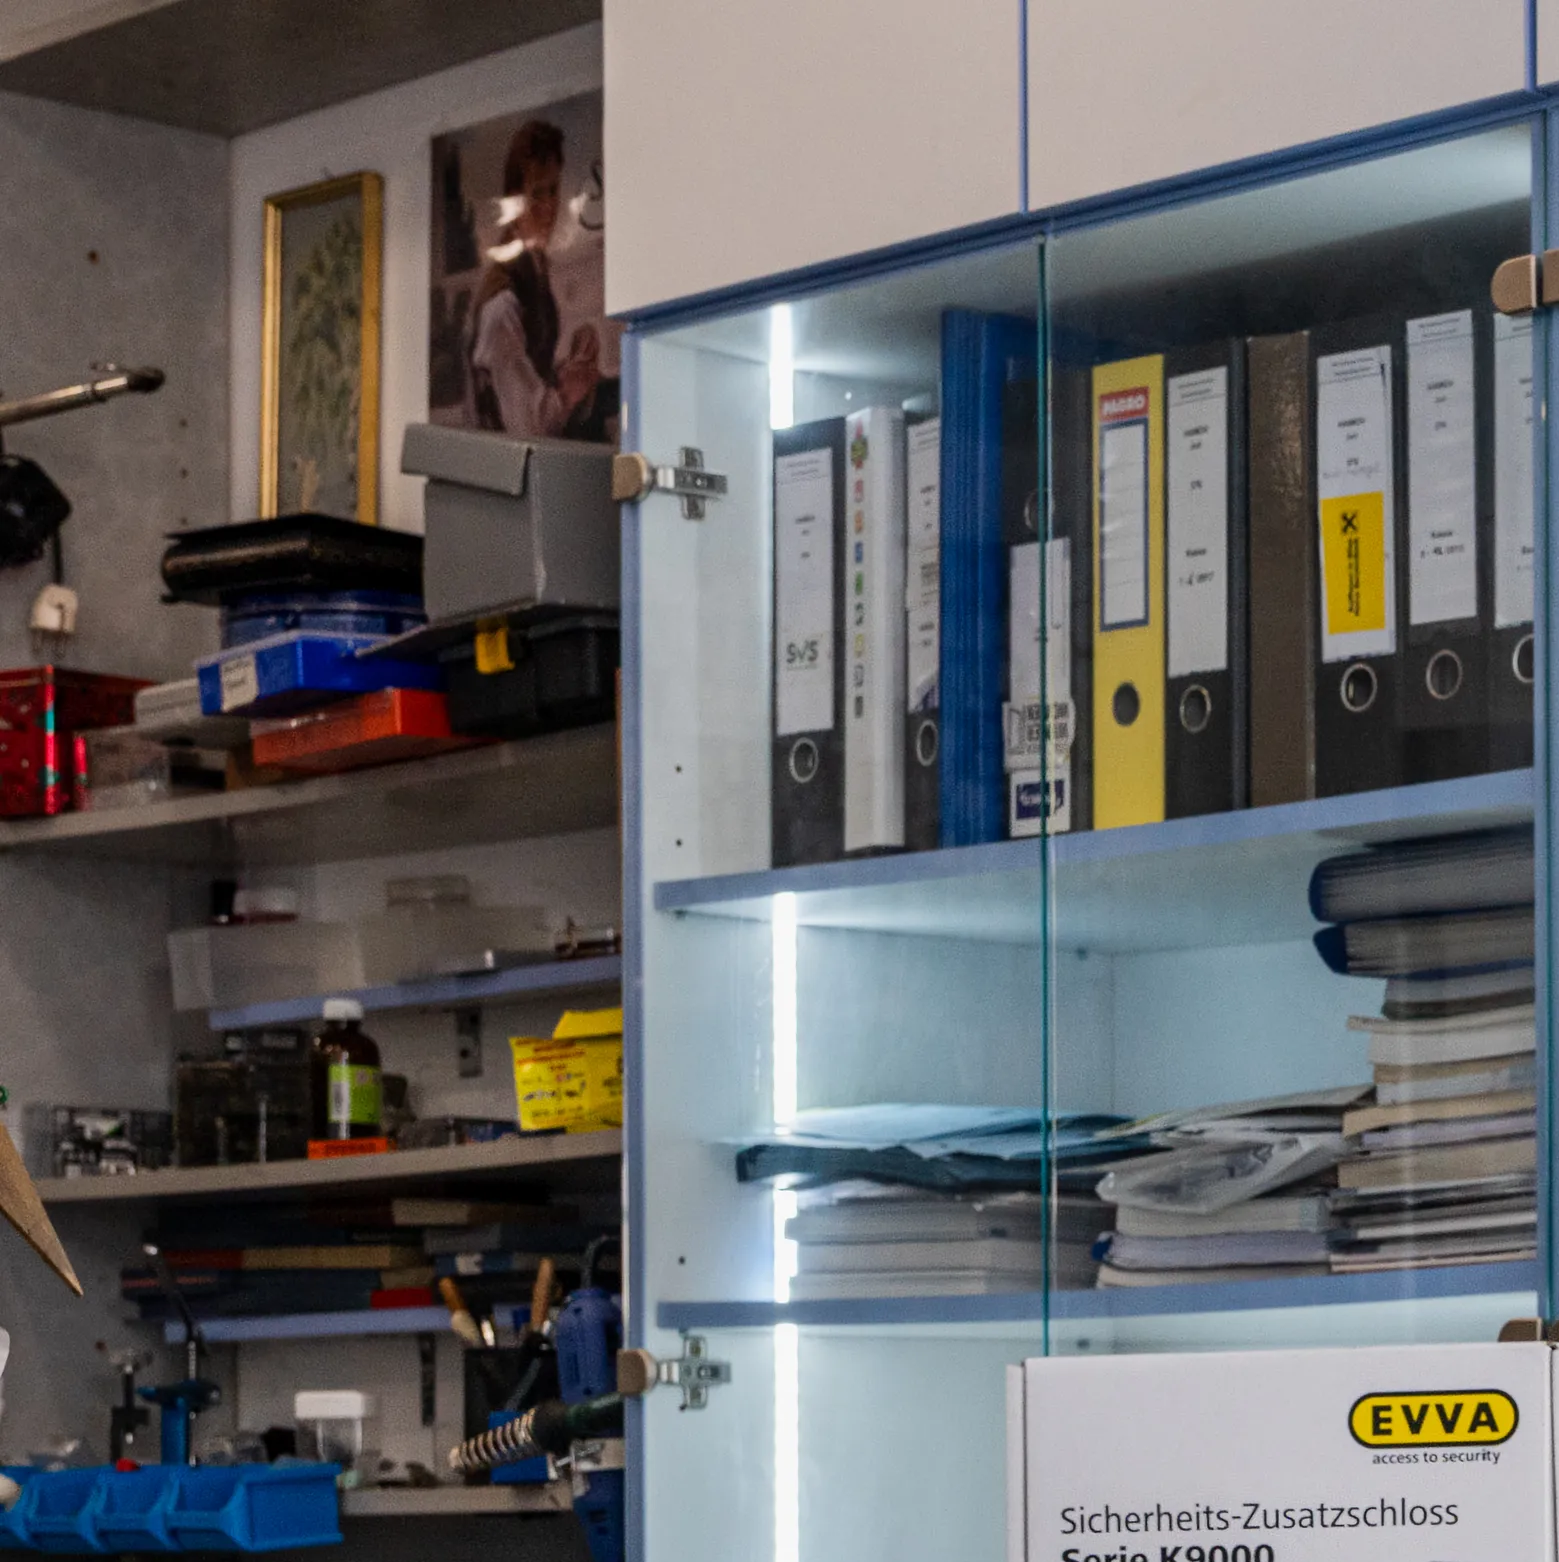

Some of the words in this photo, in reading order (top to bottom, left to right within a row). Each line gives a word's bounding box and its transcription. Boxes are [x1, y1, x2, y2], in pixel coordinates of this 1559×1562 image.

[1371, 1401, 1500, 1436] EVVA
[1371, 1451, 1419, 1465] access
[1423, 1450, 1438, 1464] to
[1441, 1448, 1501, 1465] security
[1059, 1498, 1460, 1536] Sicherheits-Zusatzschloss
